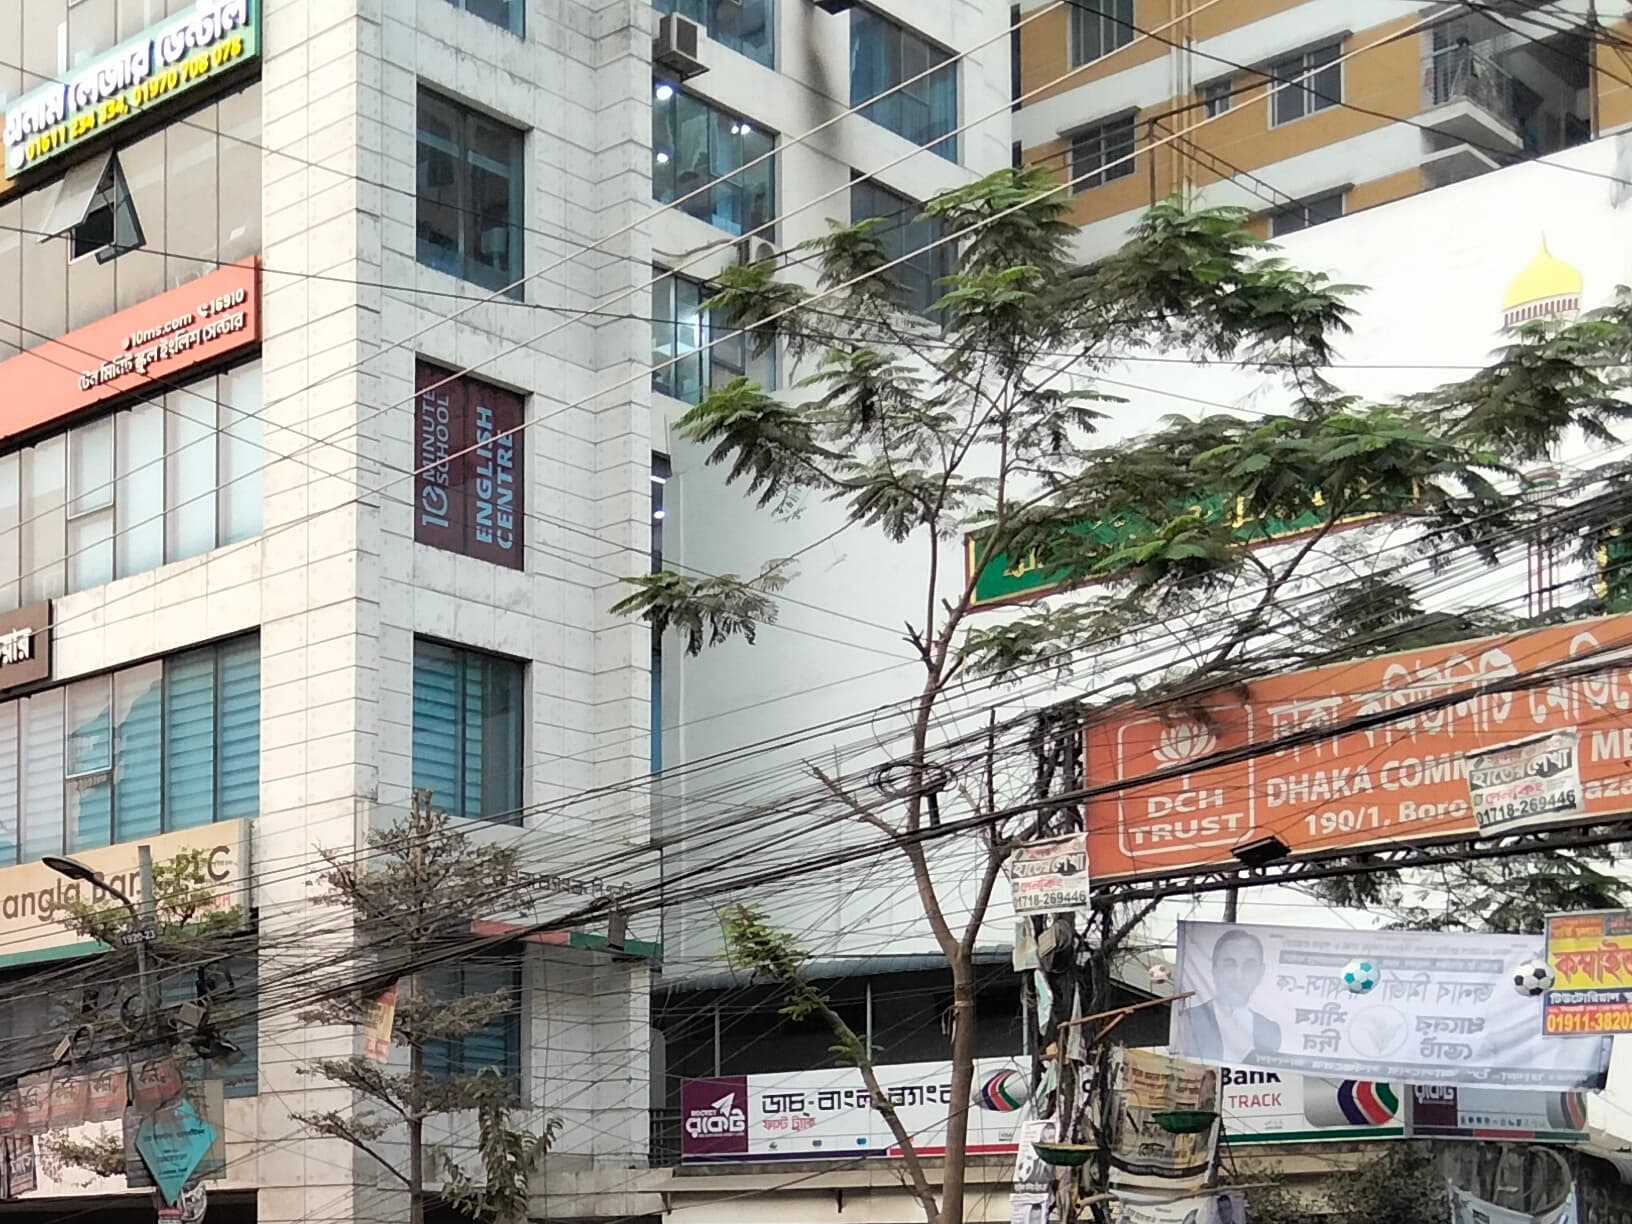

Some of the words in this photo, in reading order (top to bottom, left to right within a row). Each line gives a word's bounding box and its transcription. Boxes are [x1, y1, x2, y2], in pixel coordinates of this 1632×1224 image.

[131, 313, 193, 347] 10ms.com
[210, 288, 246, 316] 16910
[160, 330, 200, 359] ইংলিশ
[202, 311, 245, 342] সেন্টার
[423, 389, 436, 482] MINUTE
[436, 395, 449, 486] SCHOOL
[476, 406, 493, 543] ENGLISH
[497, 429, 513, 549] CENTRE
[1147, 790, 1223, 818] DCH
[1267, 764, 1371, 809] DHAKA
[1304, 804, 1392, 837] 190/1,
[1476, 789, 1576, 825] 01718-269446
[1129, 813, 1238, 845] TRUST
[121, 929, 157, 945] 1920-23
[1228, 1092, 1282, 1108] TRACK
[685, 1109, 746, 1137] রকেট
